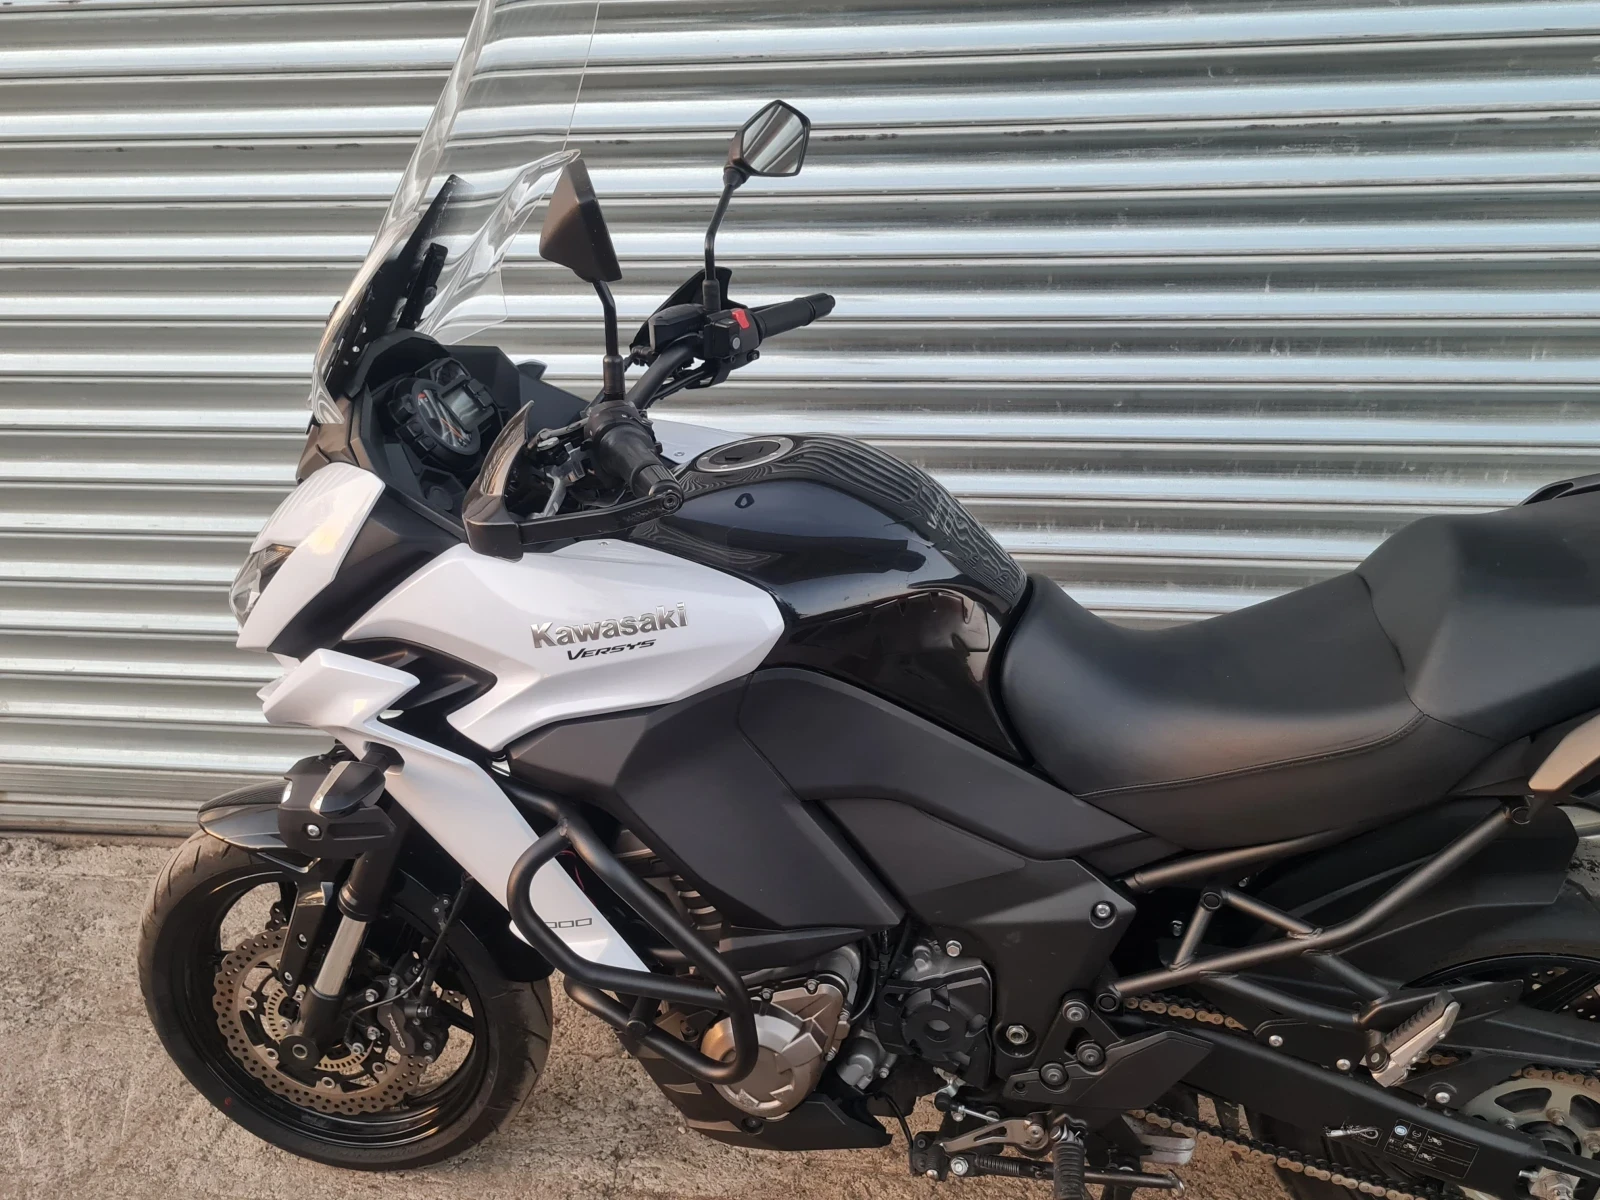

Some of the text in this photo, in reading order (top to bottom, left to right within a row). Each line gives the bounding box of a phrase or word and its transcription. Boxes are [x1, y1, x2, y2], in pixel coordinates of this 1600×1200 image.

[530, 602, 688, 648] Kawasaki
[567, 639, 657, 661] VERSYS
[387, 1013, 406, 1049] TOKICO
